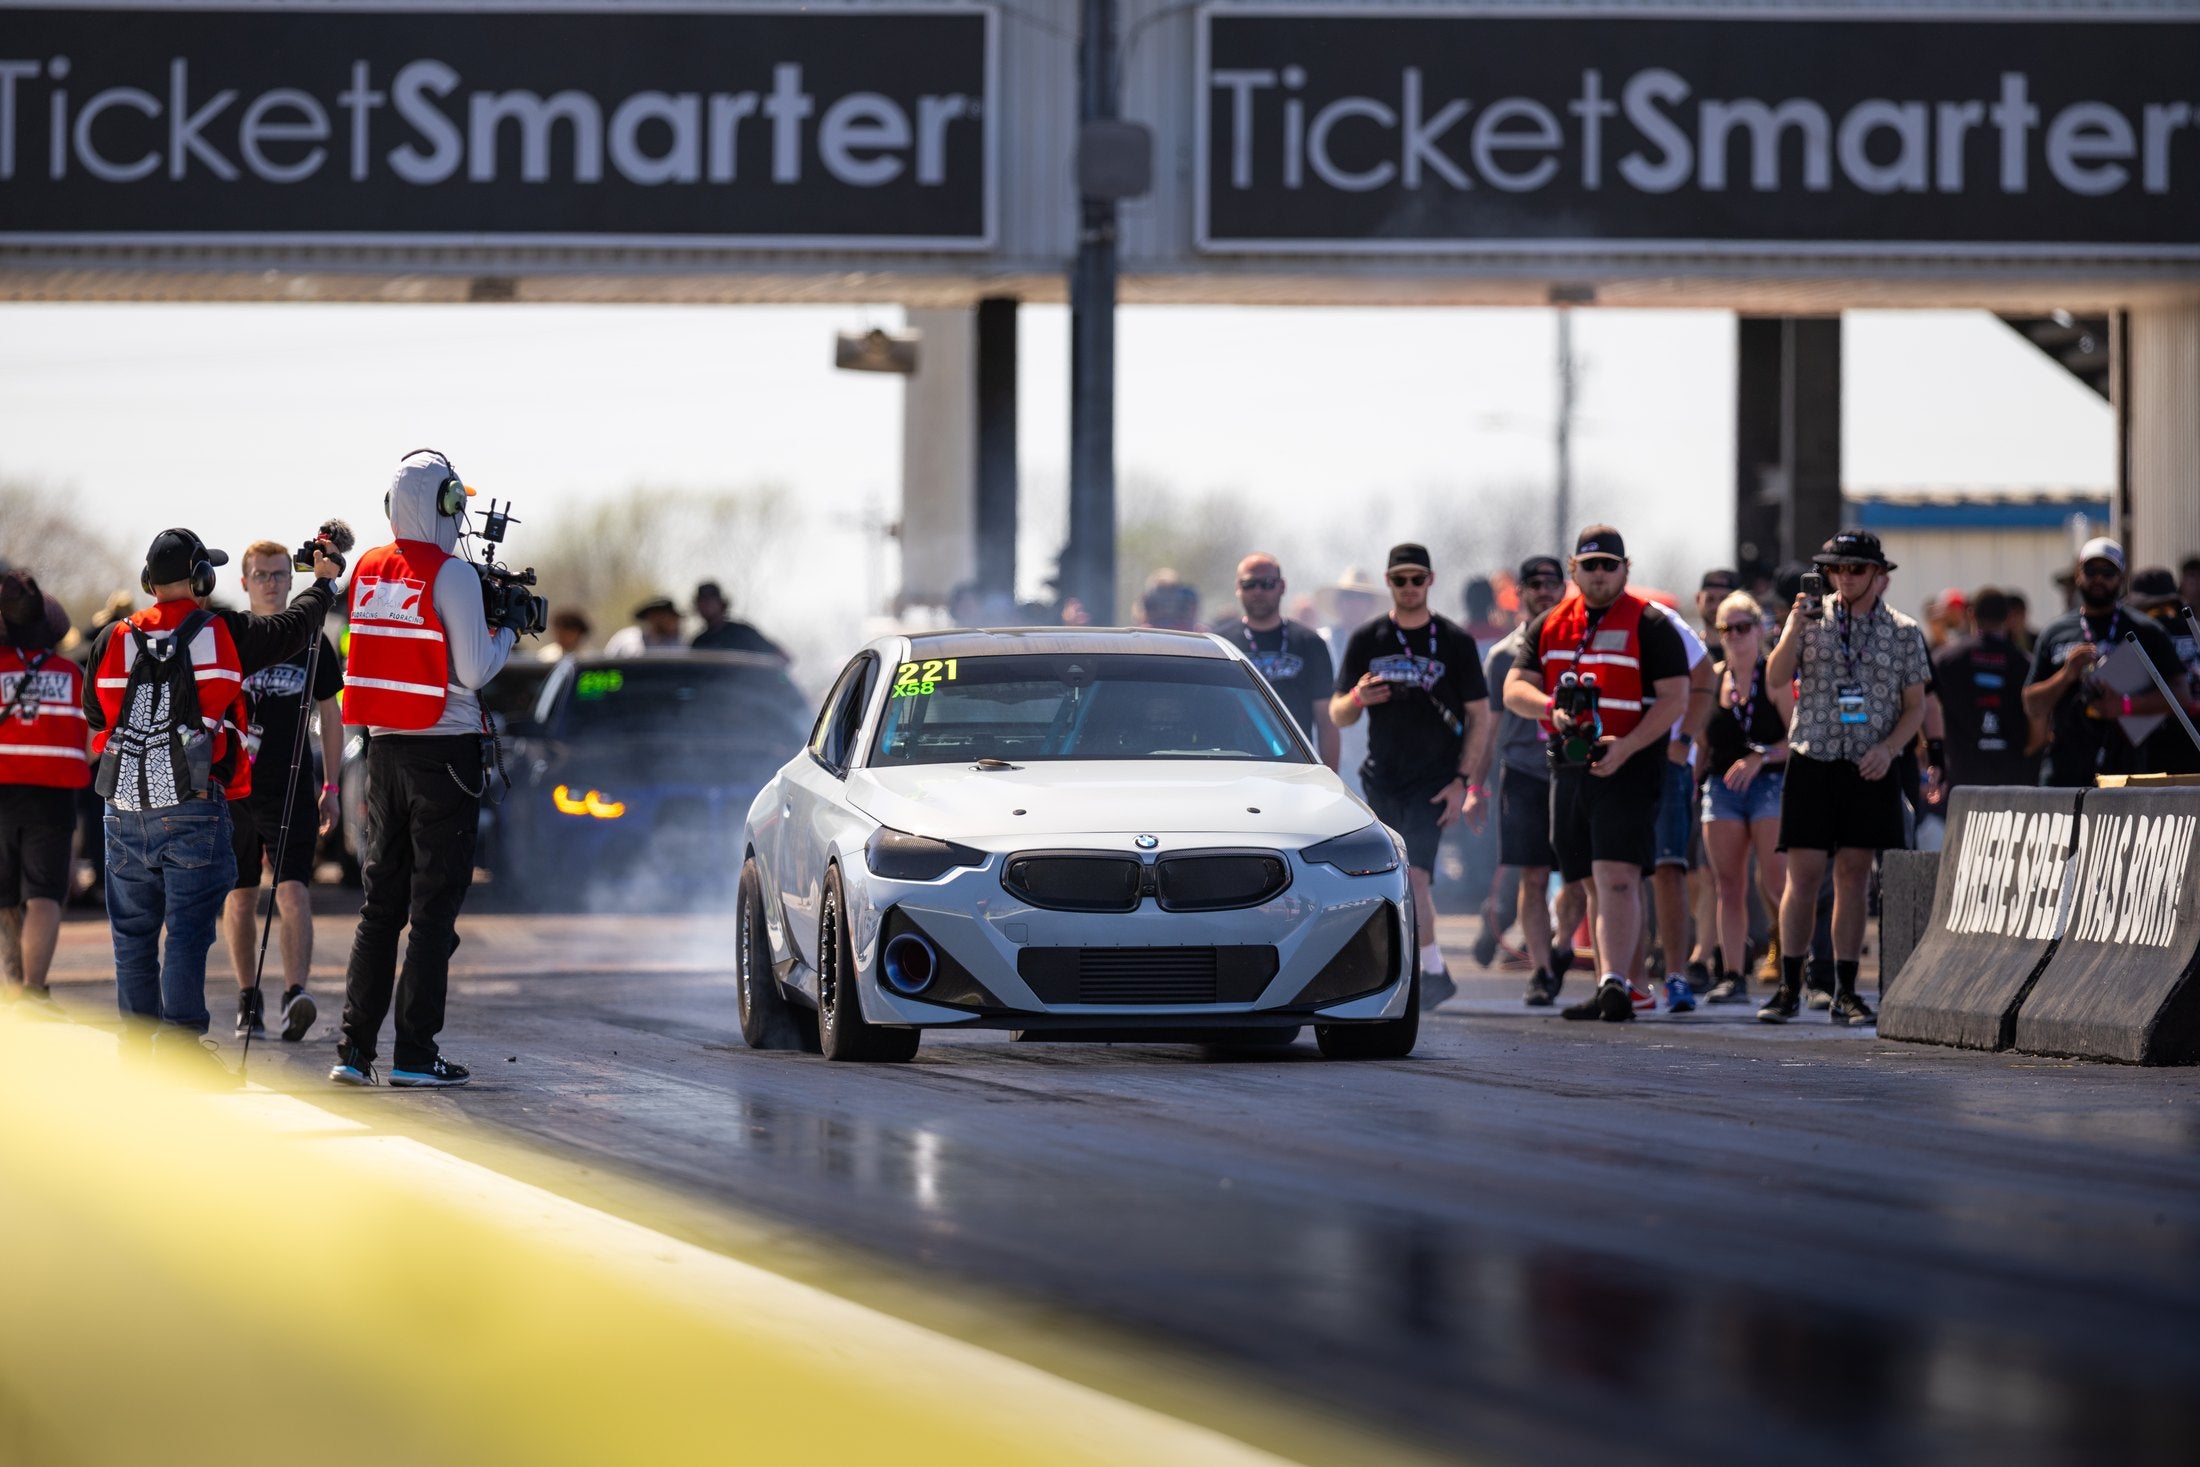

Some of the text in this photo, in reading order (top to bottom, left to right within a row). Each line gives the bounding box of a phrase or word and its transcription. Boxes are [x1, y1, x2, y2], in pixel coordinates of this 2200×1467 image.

[0, 55, 967, 187] TicketSmarter
[1211, 65, 2190, 194] TicketSmarter
[389, 612, 424, 624] FLORACING
[891, 682, 935, 699] X58
[898, 659, 957, 685] 221
[1946, 810, 2197, 947] WHERE SPEED WAS BORN!
